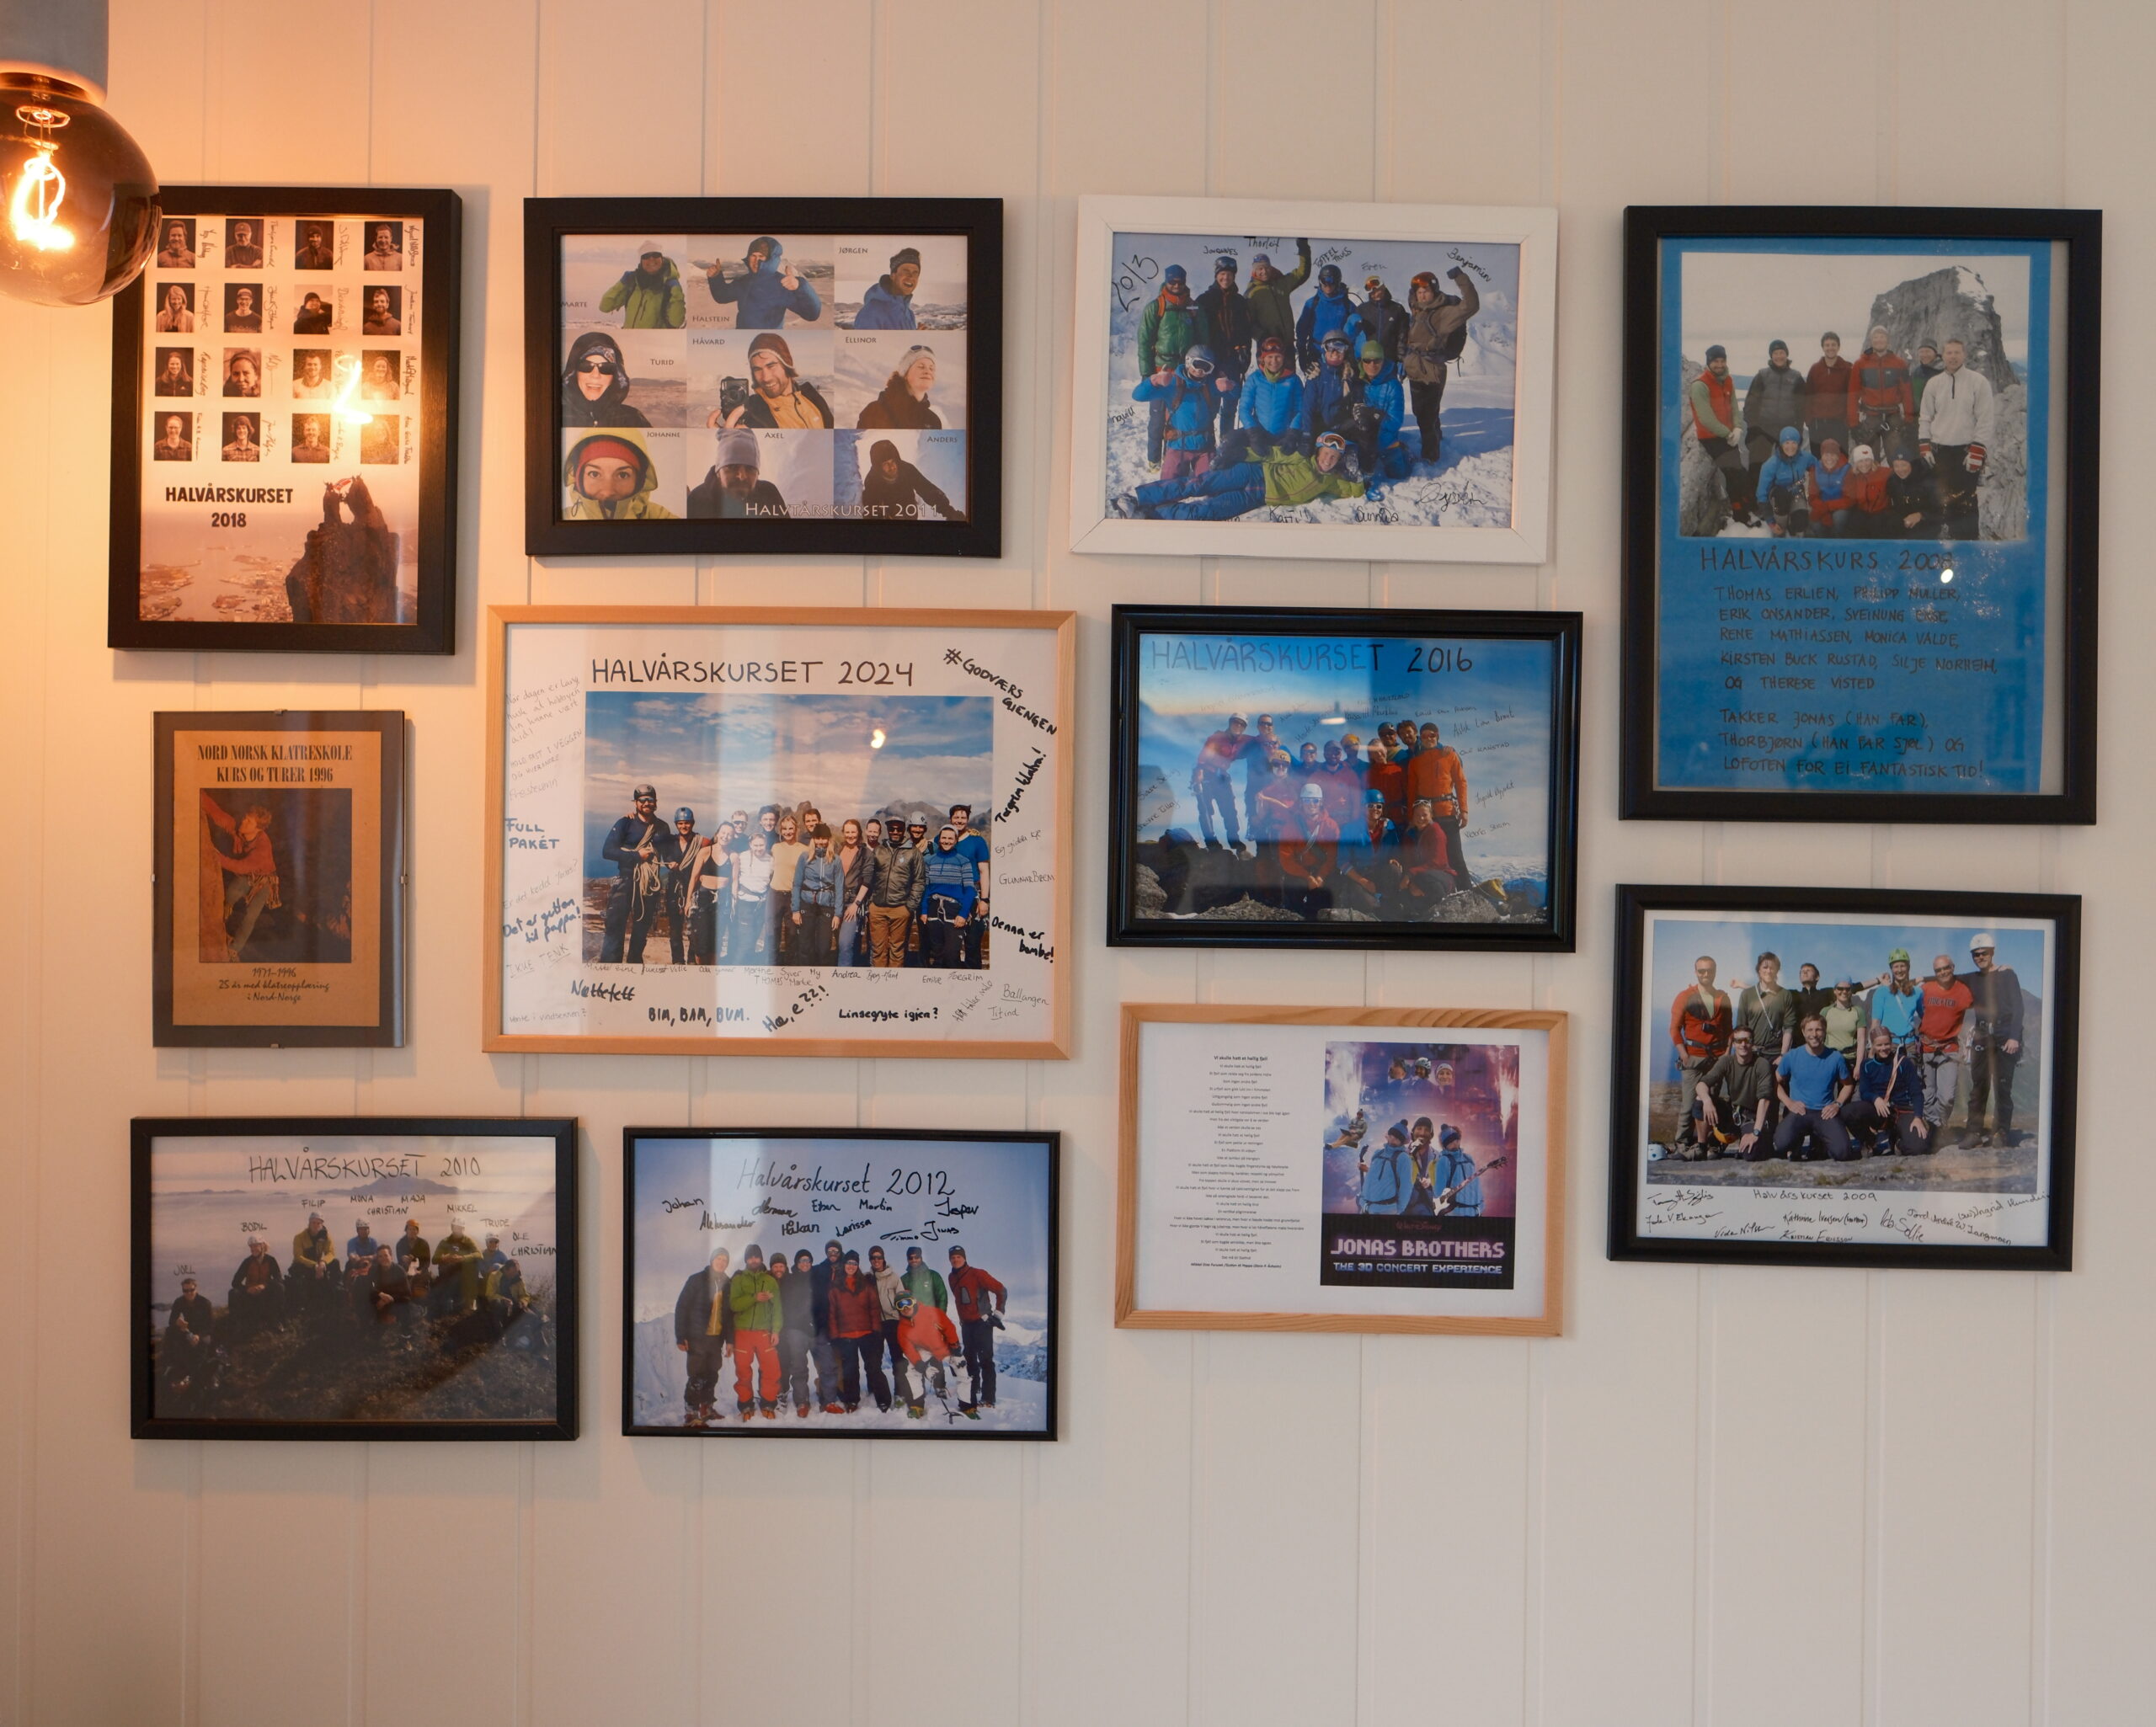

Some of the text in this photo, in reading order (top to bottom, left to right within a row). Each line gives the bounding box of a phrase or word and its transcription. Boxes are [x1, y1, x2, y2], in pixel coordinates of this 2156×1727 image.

[1446, 248, 1492, 282] Benjamin
[1112, 253, 1160, 313] 2013
[692, 337, 725, 345] HÅVARD
[165, 482, 294, 504] HALVÅRSKURSET
[895, 503, 938, 517] 2011
[211, 512, 247, 528] 2018
[1700, 545, 1954, 572] HALVÅRSKURS 2008
[1714, 585, 1772, 601] THOMAS
[1719, 608, 1753, 621] ERIK
[1844, 607, 1905, 622] SVEINUNG
[1865, 631, 1907, 644] MONICA
[1150, 637, 1473, 674] HALVÅRSKURSET 2016
[1721, 650, 1776, 666] KIRSTEN
[1785, 653, 1817, 666] BUCK
[1892, 653, 1926, 674] SILJE
[592, 652, 913, 687] HALVÅRSKURSET 2024
[1724, 674, 1875, 690] OG THERESE VISTED
[1719, 708, 1779, 724] TAKKER
[1792, 711, 1834, 729] JONAS
[1718, 732, 1802, 754] THORBJØRN
[1858, 735, 1885, 750] FAR
[1945, 737, 1964, 753] OG
[197, 744, 352, 761] NORD NORSK KLATRESKOLE
[1724, 755, 1785, 772] LOFOTEN
[1796, 759, 1826, 775] FOR
[1860, 760, 1948, 777] FANTASTISK
[216, 767, 334, 782] KURS OG TURER 1996
[504, 817, 545, 833] FULL
[831, 968, 862, 978] Andrea
[218, 979, 230, 989] 25
[232, 980, 241, 989] år
[243, 980, 261, 989] med
[253, 992, 302, 1004] Nord-Norge
[1001, 983, 1050, 1008] Ballangen
[648, 1006, 675, 1027] BIM,
[679, 1006, 712, 1027] BAM,
[248, 1146, 481, 1183] HALVÅRSKURSET 2010
[736, 1158, 956, 1196] Halvårskurset 2012
[301, 1198, 326, 1207] FILIP
[859, 1197, 893, 1212] Martin
[1843, 1191, 1877, 1202] 2009
[366, 1205, 409, 1216] CHRISTIAN
[446, 1203, 478, 1213] MIKKEL
[661, 1197, 704, 1213] Johan
[241, 1222, 268, 1233] BODIL
[479, 1218, 510, 1229] TRUDE
[781, 1219, 820, 1237] Håkan
[835, 1219, 873, 1238] Larissa
[1331, 1238, 1506, 1259] JONAS BROTHERS
[1333, 1262, 1502, 1274] THE 3D CONCERT EXPERIENCE
